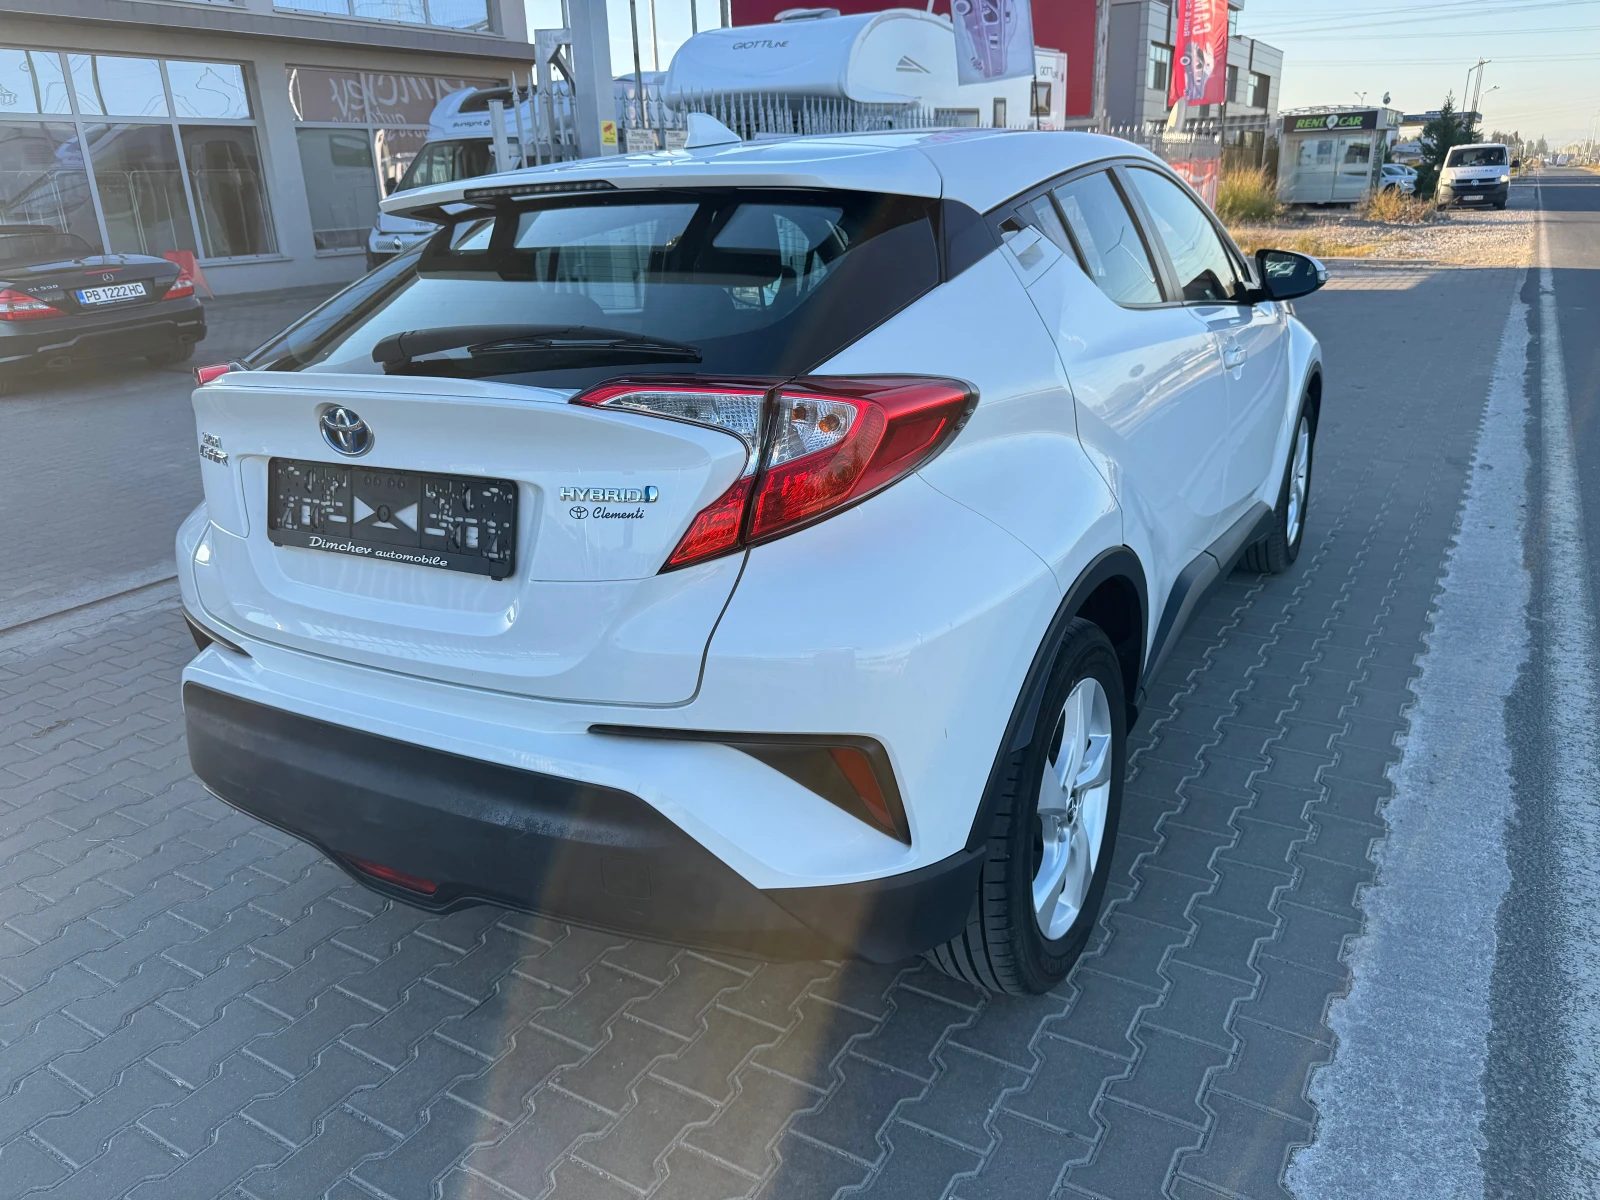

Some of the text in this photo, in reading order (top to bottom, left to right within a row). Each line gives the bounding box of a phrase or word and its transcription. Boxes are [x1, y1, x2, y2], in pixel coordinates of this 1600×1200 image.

[1338, 116, 1363, 126] CAR
[84, 290, 101, 302] PB
[102, 286, 128, 299] 1222
[127, 284, 144, 296] HC
[560, 486, 643, 503] HYBRID
[592, 507, 645, 519] Clementi
[309, 536, 448, 567] Dimchev automobile
